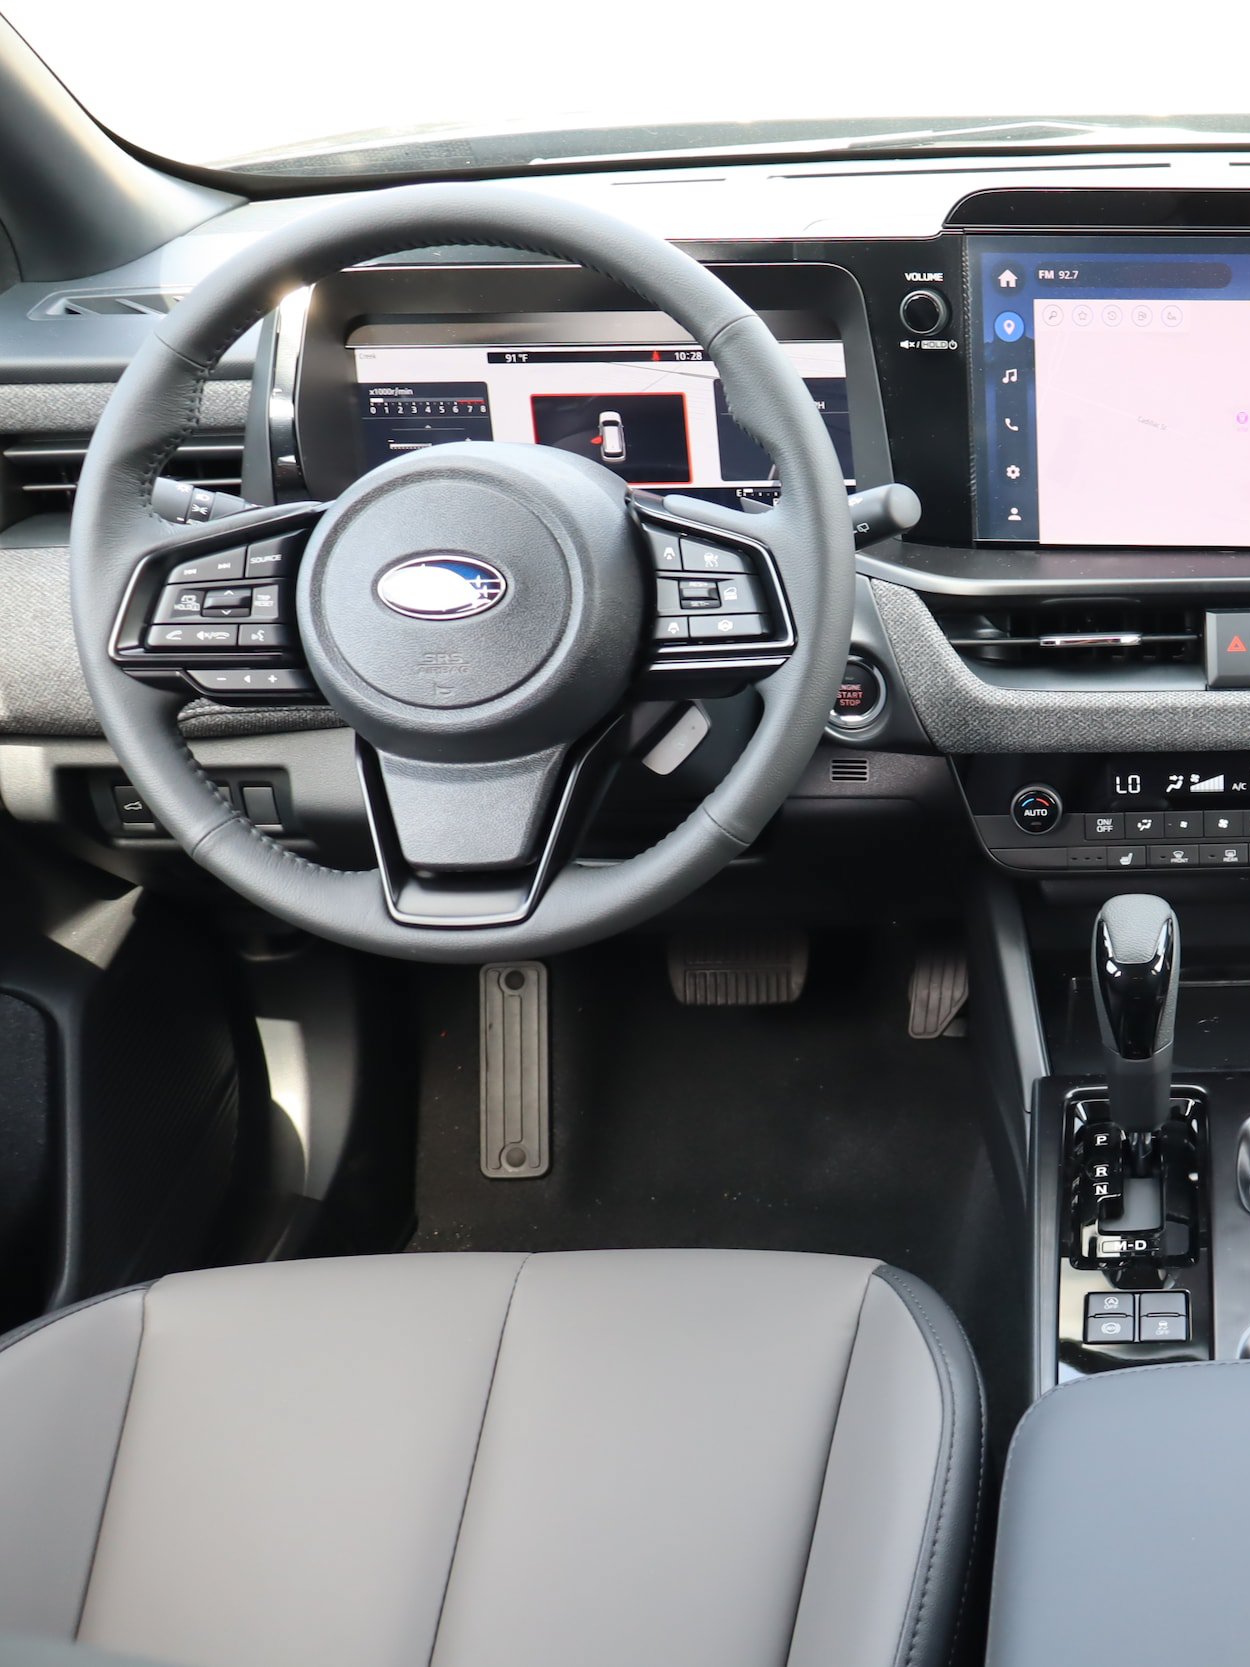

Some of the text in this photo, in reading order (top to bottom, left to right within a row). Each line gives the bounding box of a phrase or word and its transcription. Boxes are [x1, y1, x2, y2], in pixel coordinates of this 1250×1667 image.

[904, 272, 944, 282] VOLUME
[1038, 270, 1079, 280] FM 92.7
[922, 340, 948, 349] HOLD
[674, 351, 703, 361] 10:28
[736, 489, 742, 497] E
[250, 554, 282, 564] SOURCE
[423, 652, 465, 664] SRS
[416, 665, 471, 674] AIRBAG
[836, 691, 863, 699] START
[1115, 774, 1141, 794] LO
[1231, 782, 1247, 791] A/C
[1023, 809, 1048, 817] AUTO
[1096, 825, 1113, 833] OFF
[1095, 1135, 1108, 1145] P
[1095, 1166, 1108, 1177] R
[1095, 1184, 1108, 1195] N
